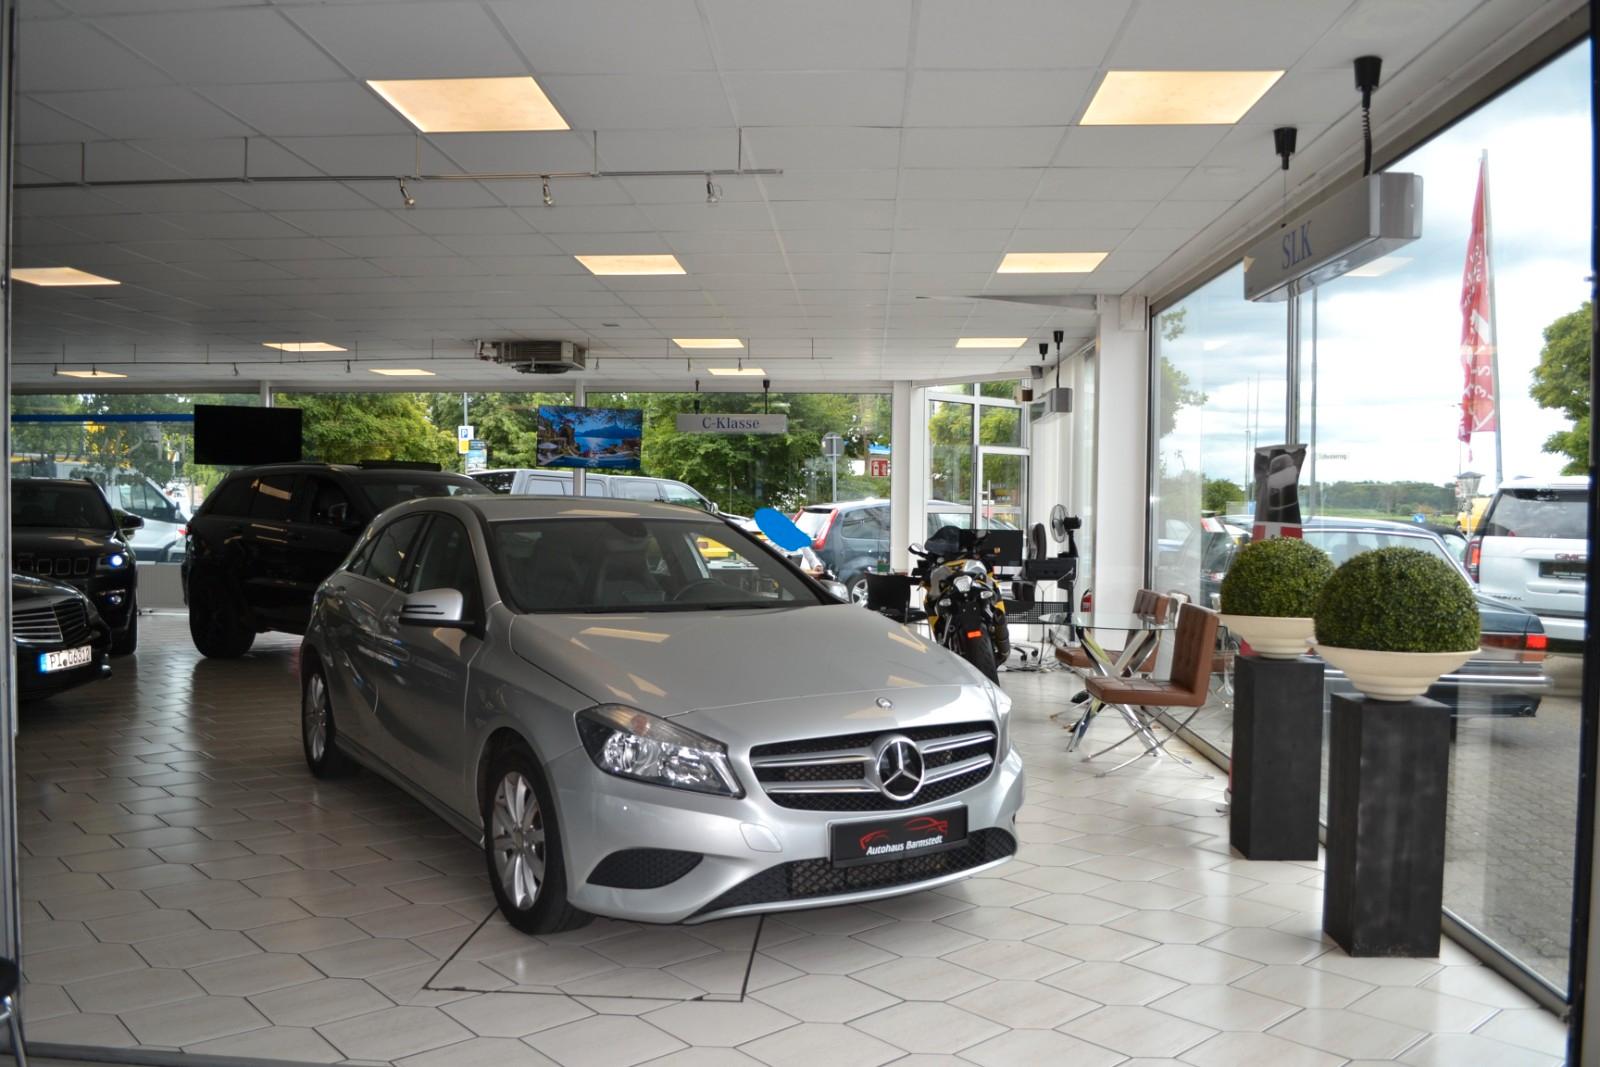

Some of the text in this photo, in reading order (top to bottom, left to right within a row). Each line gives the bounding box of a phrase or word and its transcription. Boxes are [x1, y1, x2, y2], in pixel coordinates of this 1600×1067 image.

[1282, 220, 1312, 270] SLK
[702, 416, 760, 430] C-Klasse
[865, 834, 943, 856] Autohaus Barmstedt
